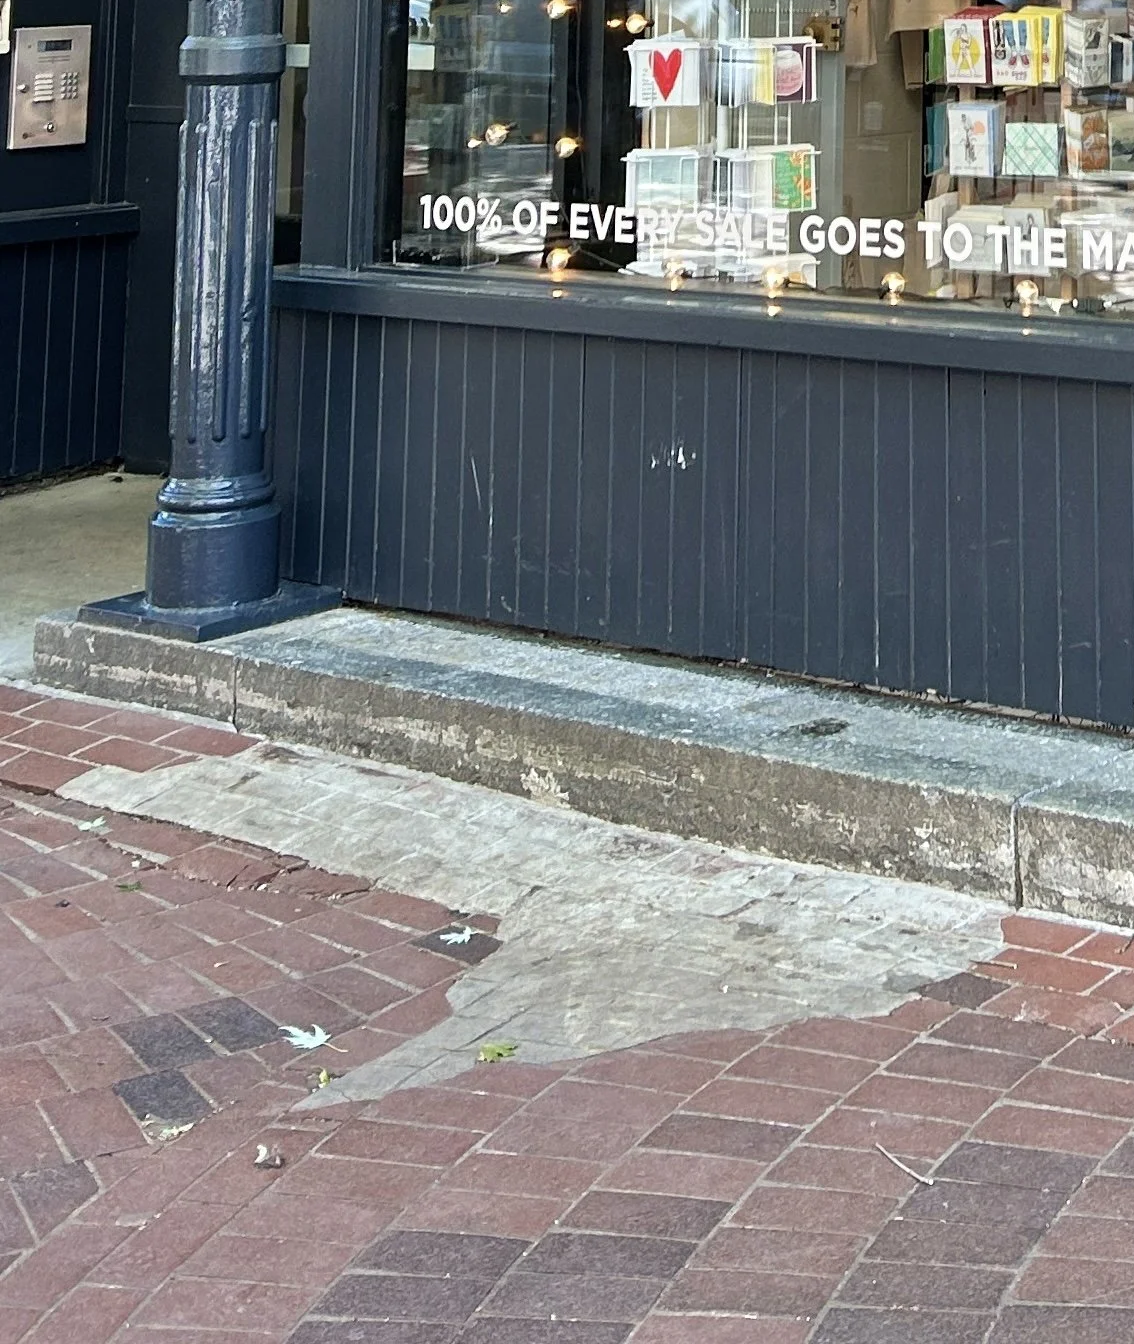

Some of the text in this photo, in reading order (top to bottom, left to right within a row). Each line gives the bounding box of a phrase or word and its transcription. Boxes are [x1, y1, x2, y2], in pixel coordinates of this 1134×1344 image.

[420, 194, 503, 232] 100%
[512, 200, 561, 237] OF
[569, 201, 681, 246] EVERY
[695, 210, 789, 252] SALE
[799, 215, 906, 260] GOES
[917, 220, 974, 262] TO
[986, 223, 1068, 269] THE
